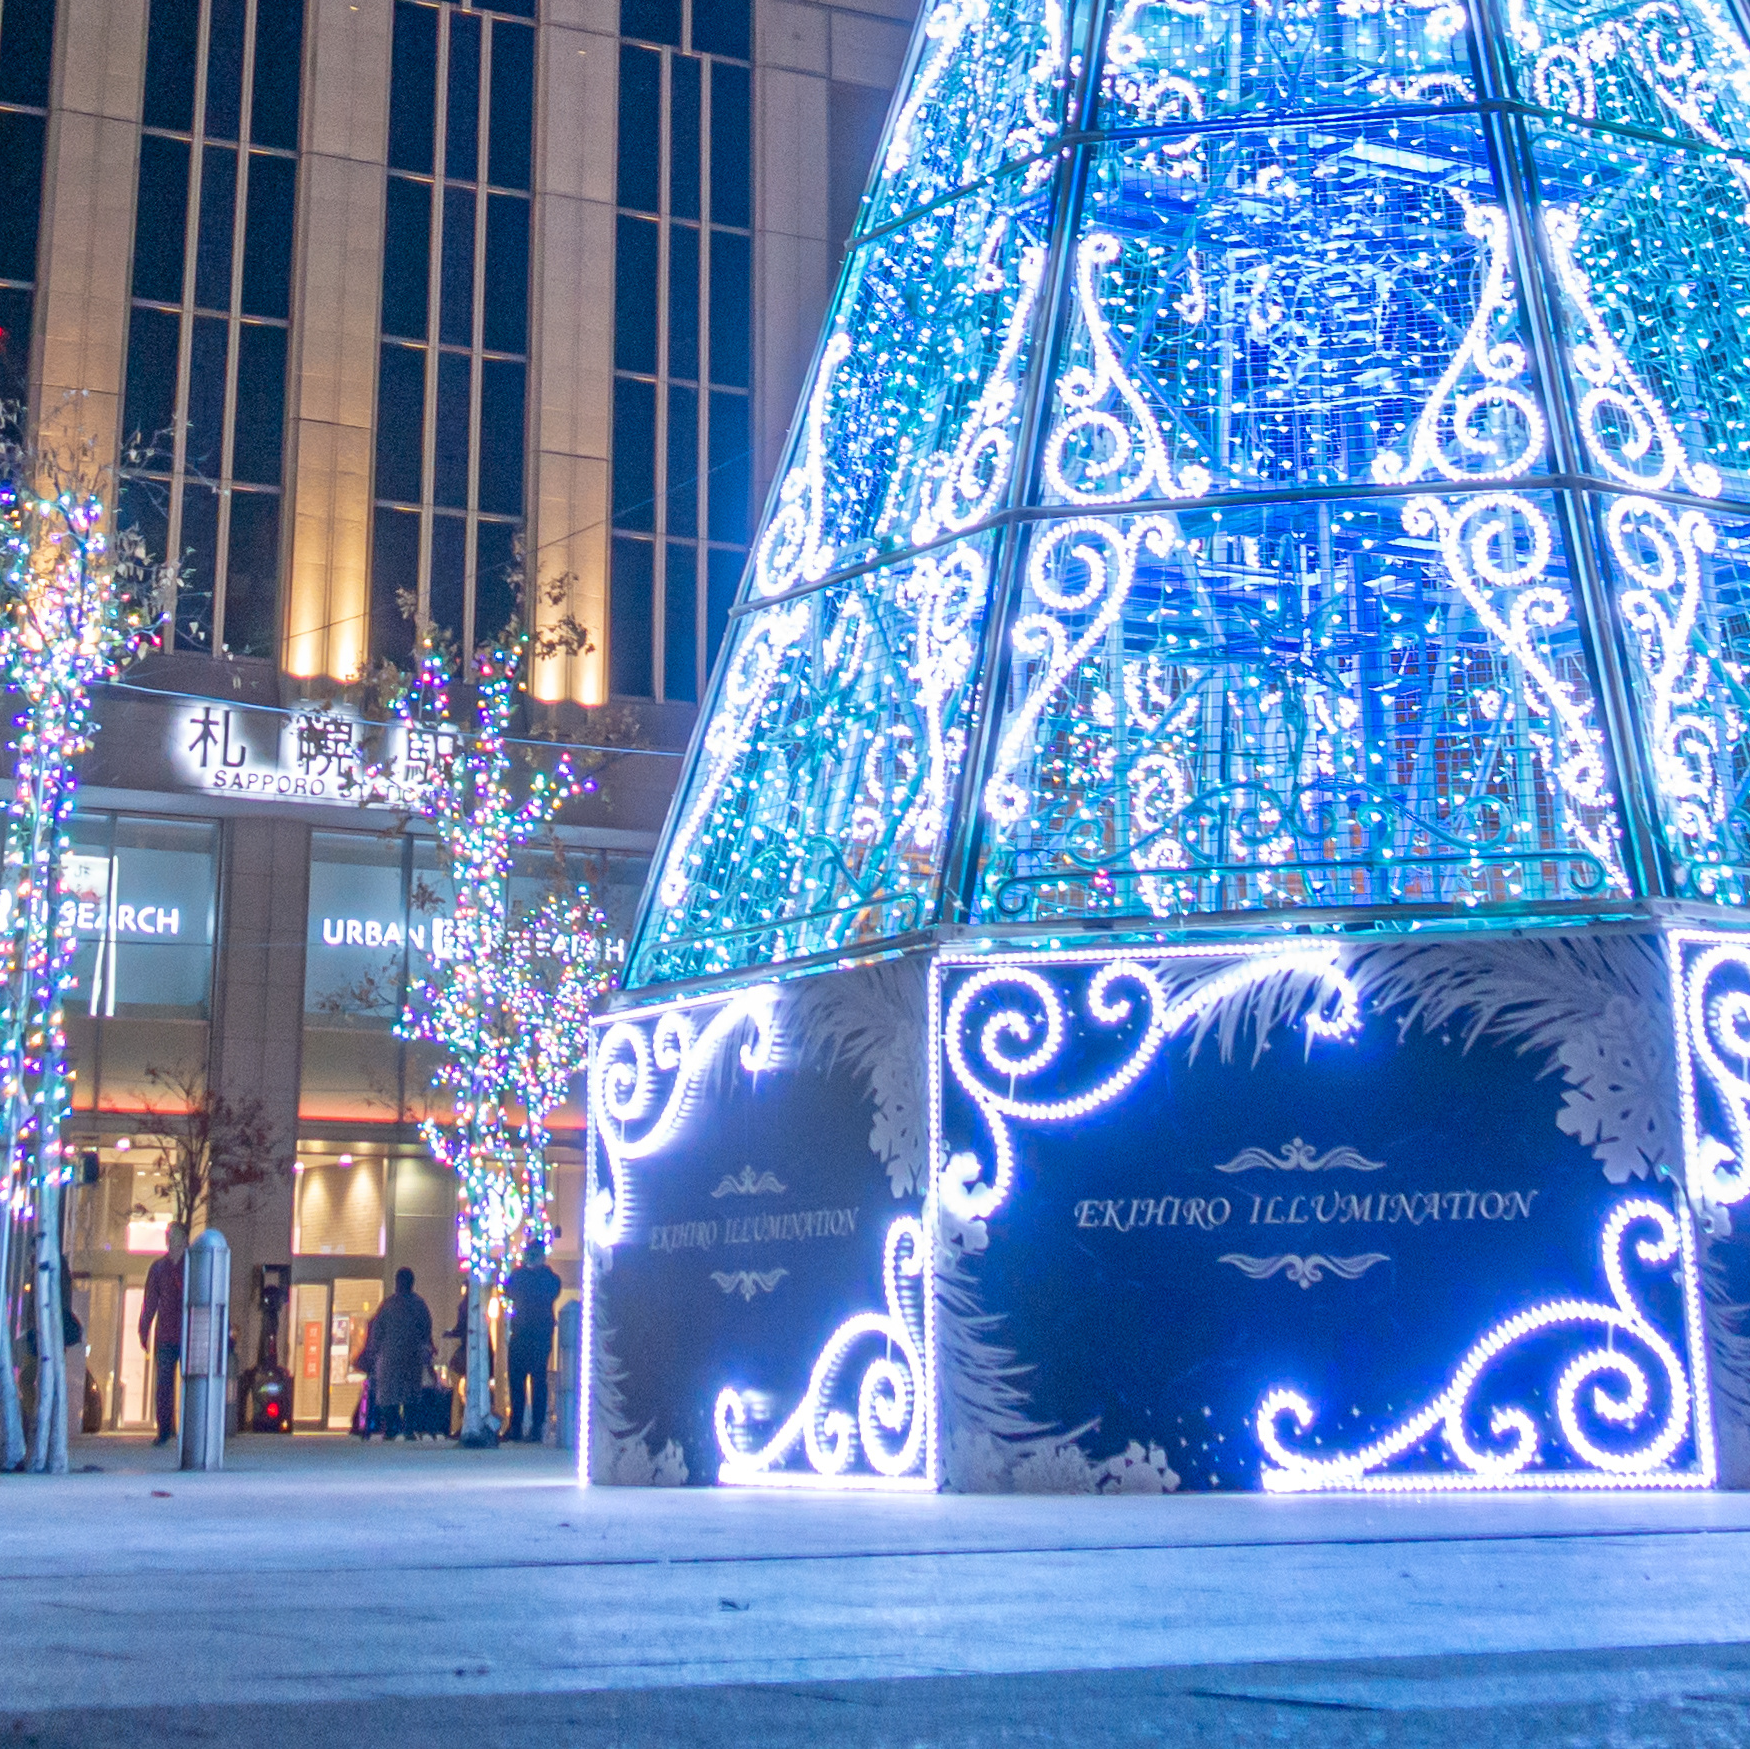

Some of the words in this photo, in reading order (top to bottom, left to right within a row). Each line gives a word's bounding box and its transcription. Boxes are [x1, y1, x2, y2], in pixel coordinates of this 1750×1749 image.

[213, 769, 326, 796] SAPPORO
[21, 898, 179, 935] SEARCH
[322, 917, 425, 951] URBAN
[723, 1206, 860, 1246] ILLUMINATION
[1074, 1196, 1232, 1231] EKIHIRO
[1249, 1189, 1539, 1226] ILLUMINATION
